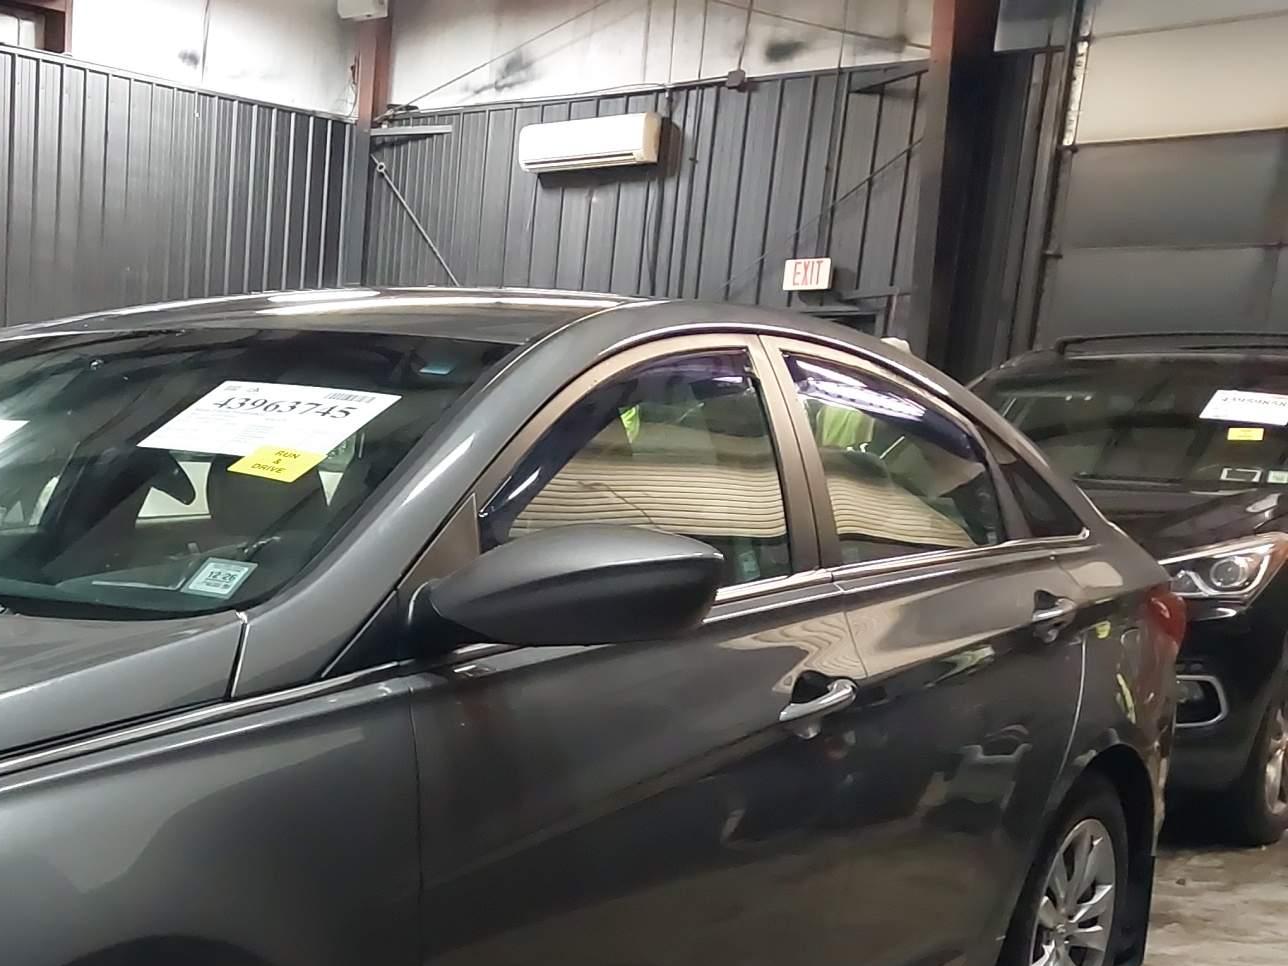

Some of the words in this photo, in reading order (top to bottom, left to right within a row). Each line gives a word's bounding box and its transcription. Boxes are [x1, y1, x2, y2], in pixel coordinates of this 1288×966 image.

[792, 260, 824, 286] EXIT
[212, 396, 359, 419] 43963745
[274, 450, 301, 460] RUN
[250, 463, 287, 475] DRIVE
